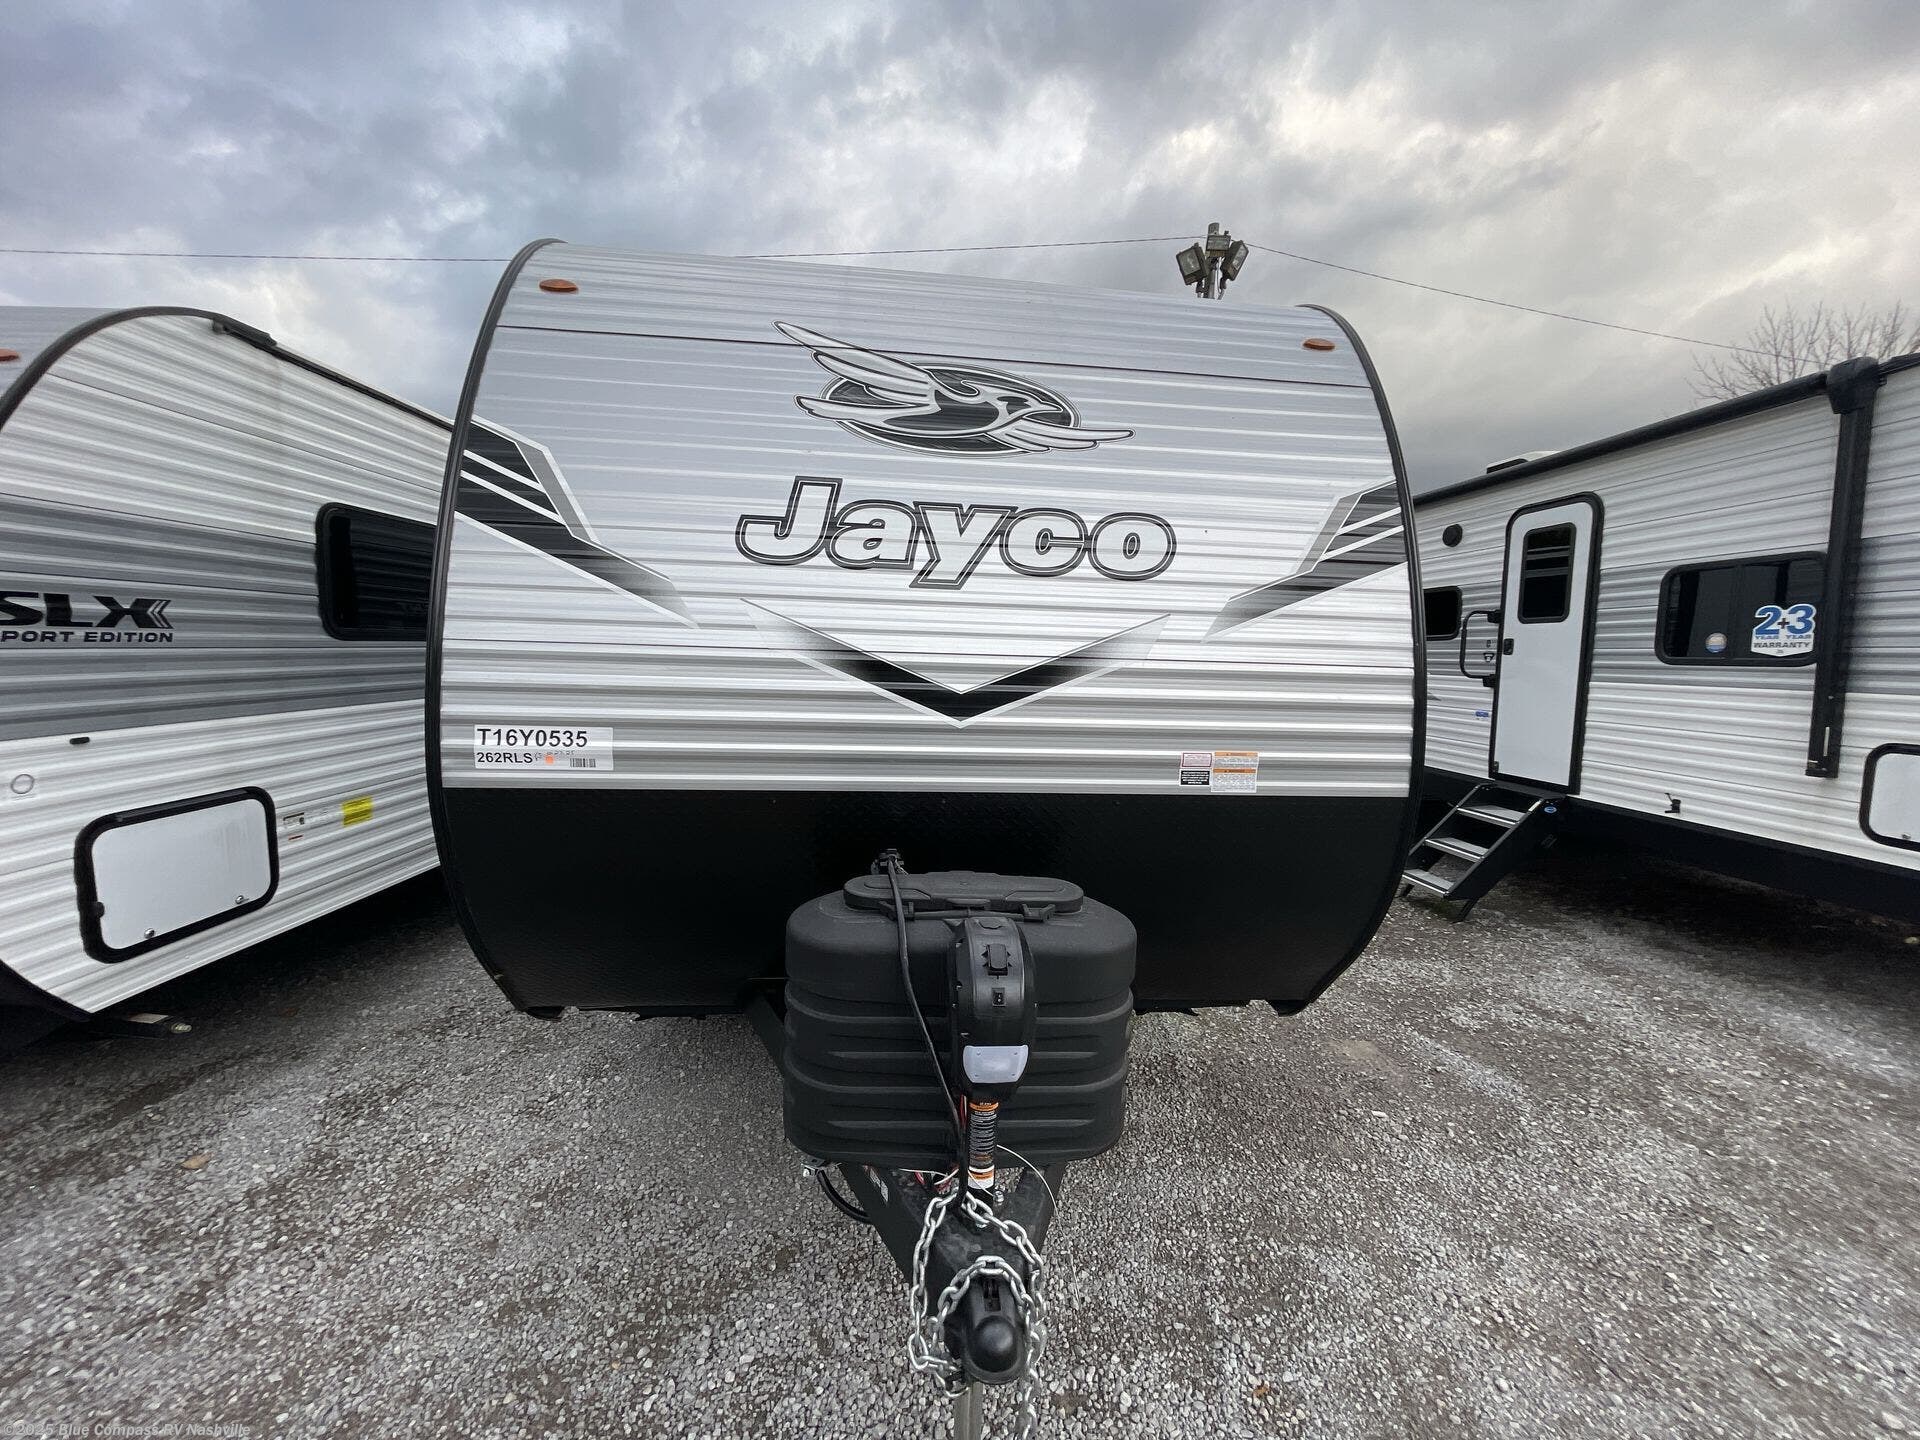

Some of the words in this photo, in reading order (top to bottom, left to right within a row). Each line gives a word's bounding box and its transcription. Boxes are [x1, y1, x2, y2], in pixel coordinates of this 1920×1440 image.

[735, 475, 1177, 590] Jayco
[0, 590, 174, 629] SLX
[1, 630, 74, 643] PORT
[83, 631, 173, 643] EDITION
[476, 728, 588, 748] T16Y0535
[476, 752, 533, 764] 262RLS
